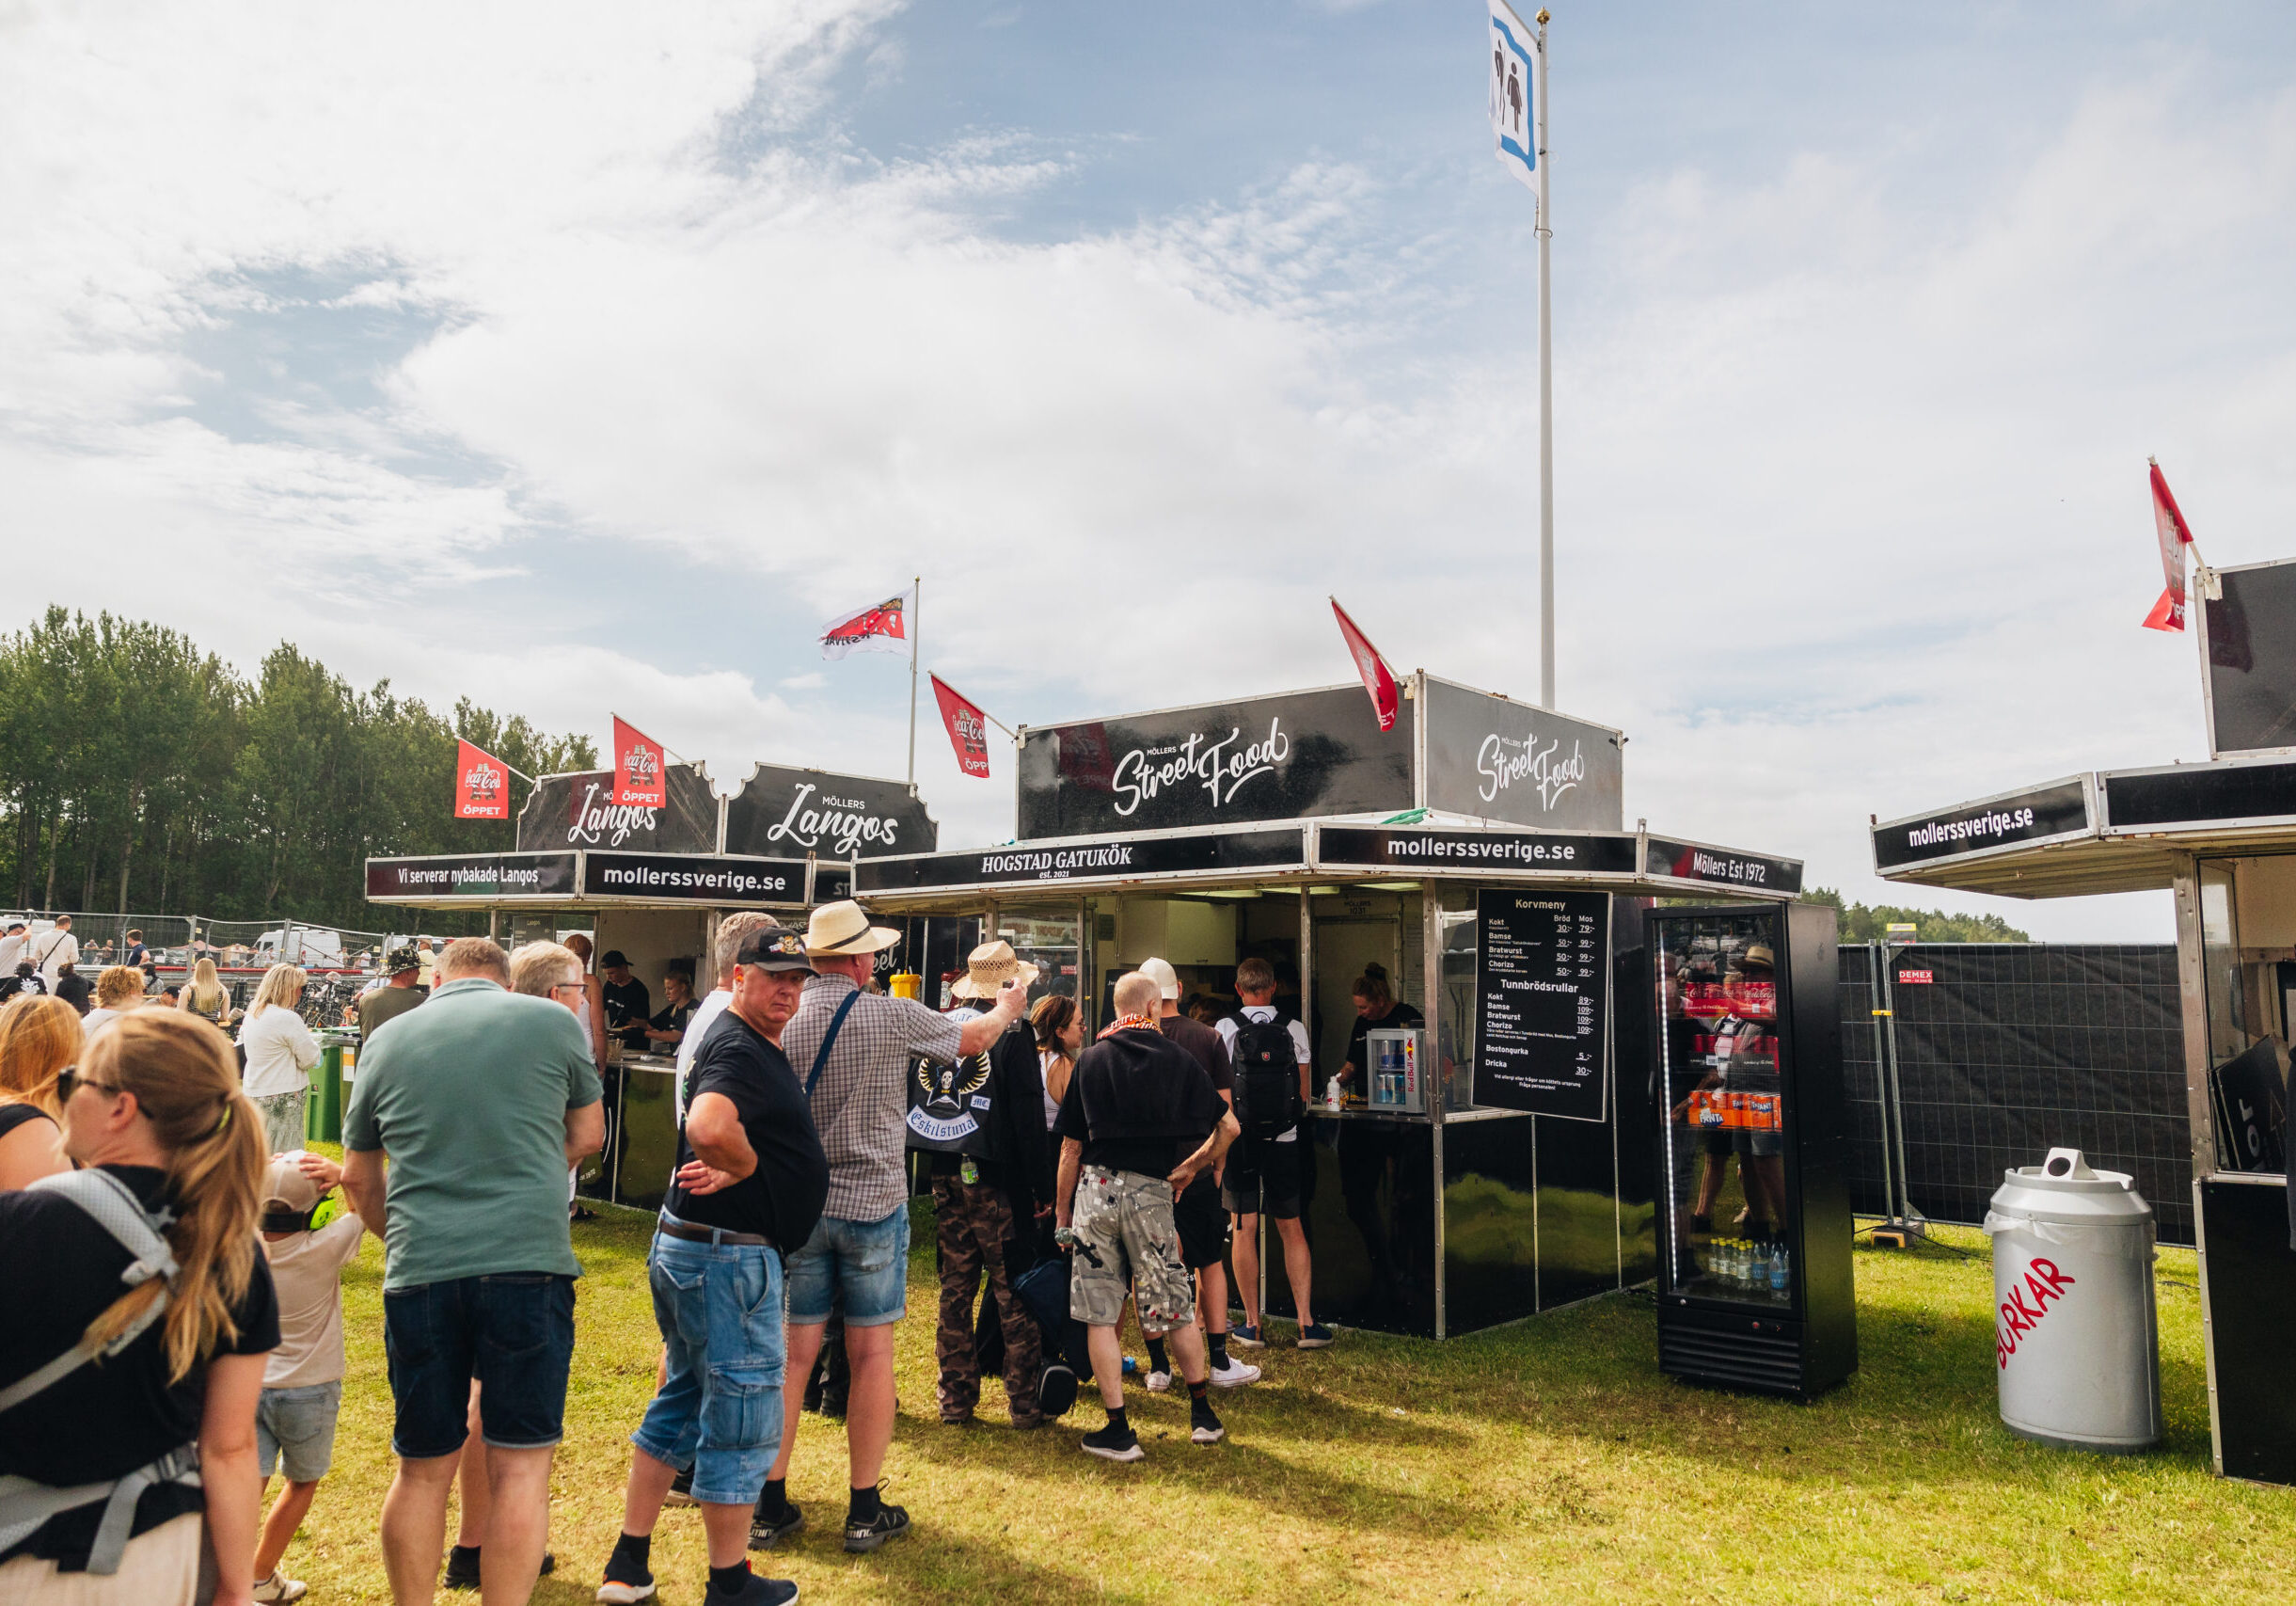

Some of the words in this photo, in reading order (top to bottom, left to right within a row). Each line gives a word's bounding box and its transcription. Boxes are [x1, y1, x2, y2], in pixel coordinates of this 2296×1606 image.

[1147, 746, 1177, 756] MÖLLERS
[1112, 733, 1204, 816] Street
[1197, 717, 1289, 807] Food
[1477, 733, 1538, 803] Street
[1532, 738, 1585, 812] Food
[622, 791, 659, 803] ÖPPET
[822, 795, 865, 810] MÖLLERS
[463, 804, 500, 816] ÖPPET
[567, 783, 658, 847] Langos
[768, 783, 898, 854] Langos
[1908, 805, 2035, 847] mollerssverige.se
[1387, 836, 1576, 864] mollerssverige.se
[981, 852, 1053, 873] HOGSTAD
[1055, 844, 1132, 868] GATUKÖK
[1053, 870, 1069, 879] 2021
[1693, 851, 1726, 877] Möllers
[1727, 860, 1744, 879] Est
[1745, 862, 1766, 883] 1972
[398, 867, 407, 883] Vi
[409, 869, 450, 884] serverar
[451, 867, 498, 886] nybakade
[500, 867, 538, 884] Langos
[603, 867, 786, 892] mollerssverige.se
[1515, 898, 1566, 911] Korvmeny
[1489, 960, 1514, 968] Chorizo
[1899, 970, 1932, 978] DEMEX
[1500, 978, 1579, 993] Tunnbrödsrullar
[1487, 1002, 1510, 1010] Bamse
[1487, 1011, 1521, 1021] Bratwurst
[1486, 1021, 1512, 1029] Chorizo
[1486, 1044, 1528, 1056] Bostongurka
[1485, 1059, 1507, 1068] Dricka
[910, 1111, 975, 1137] Eskilstuna
